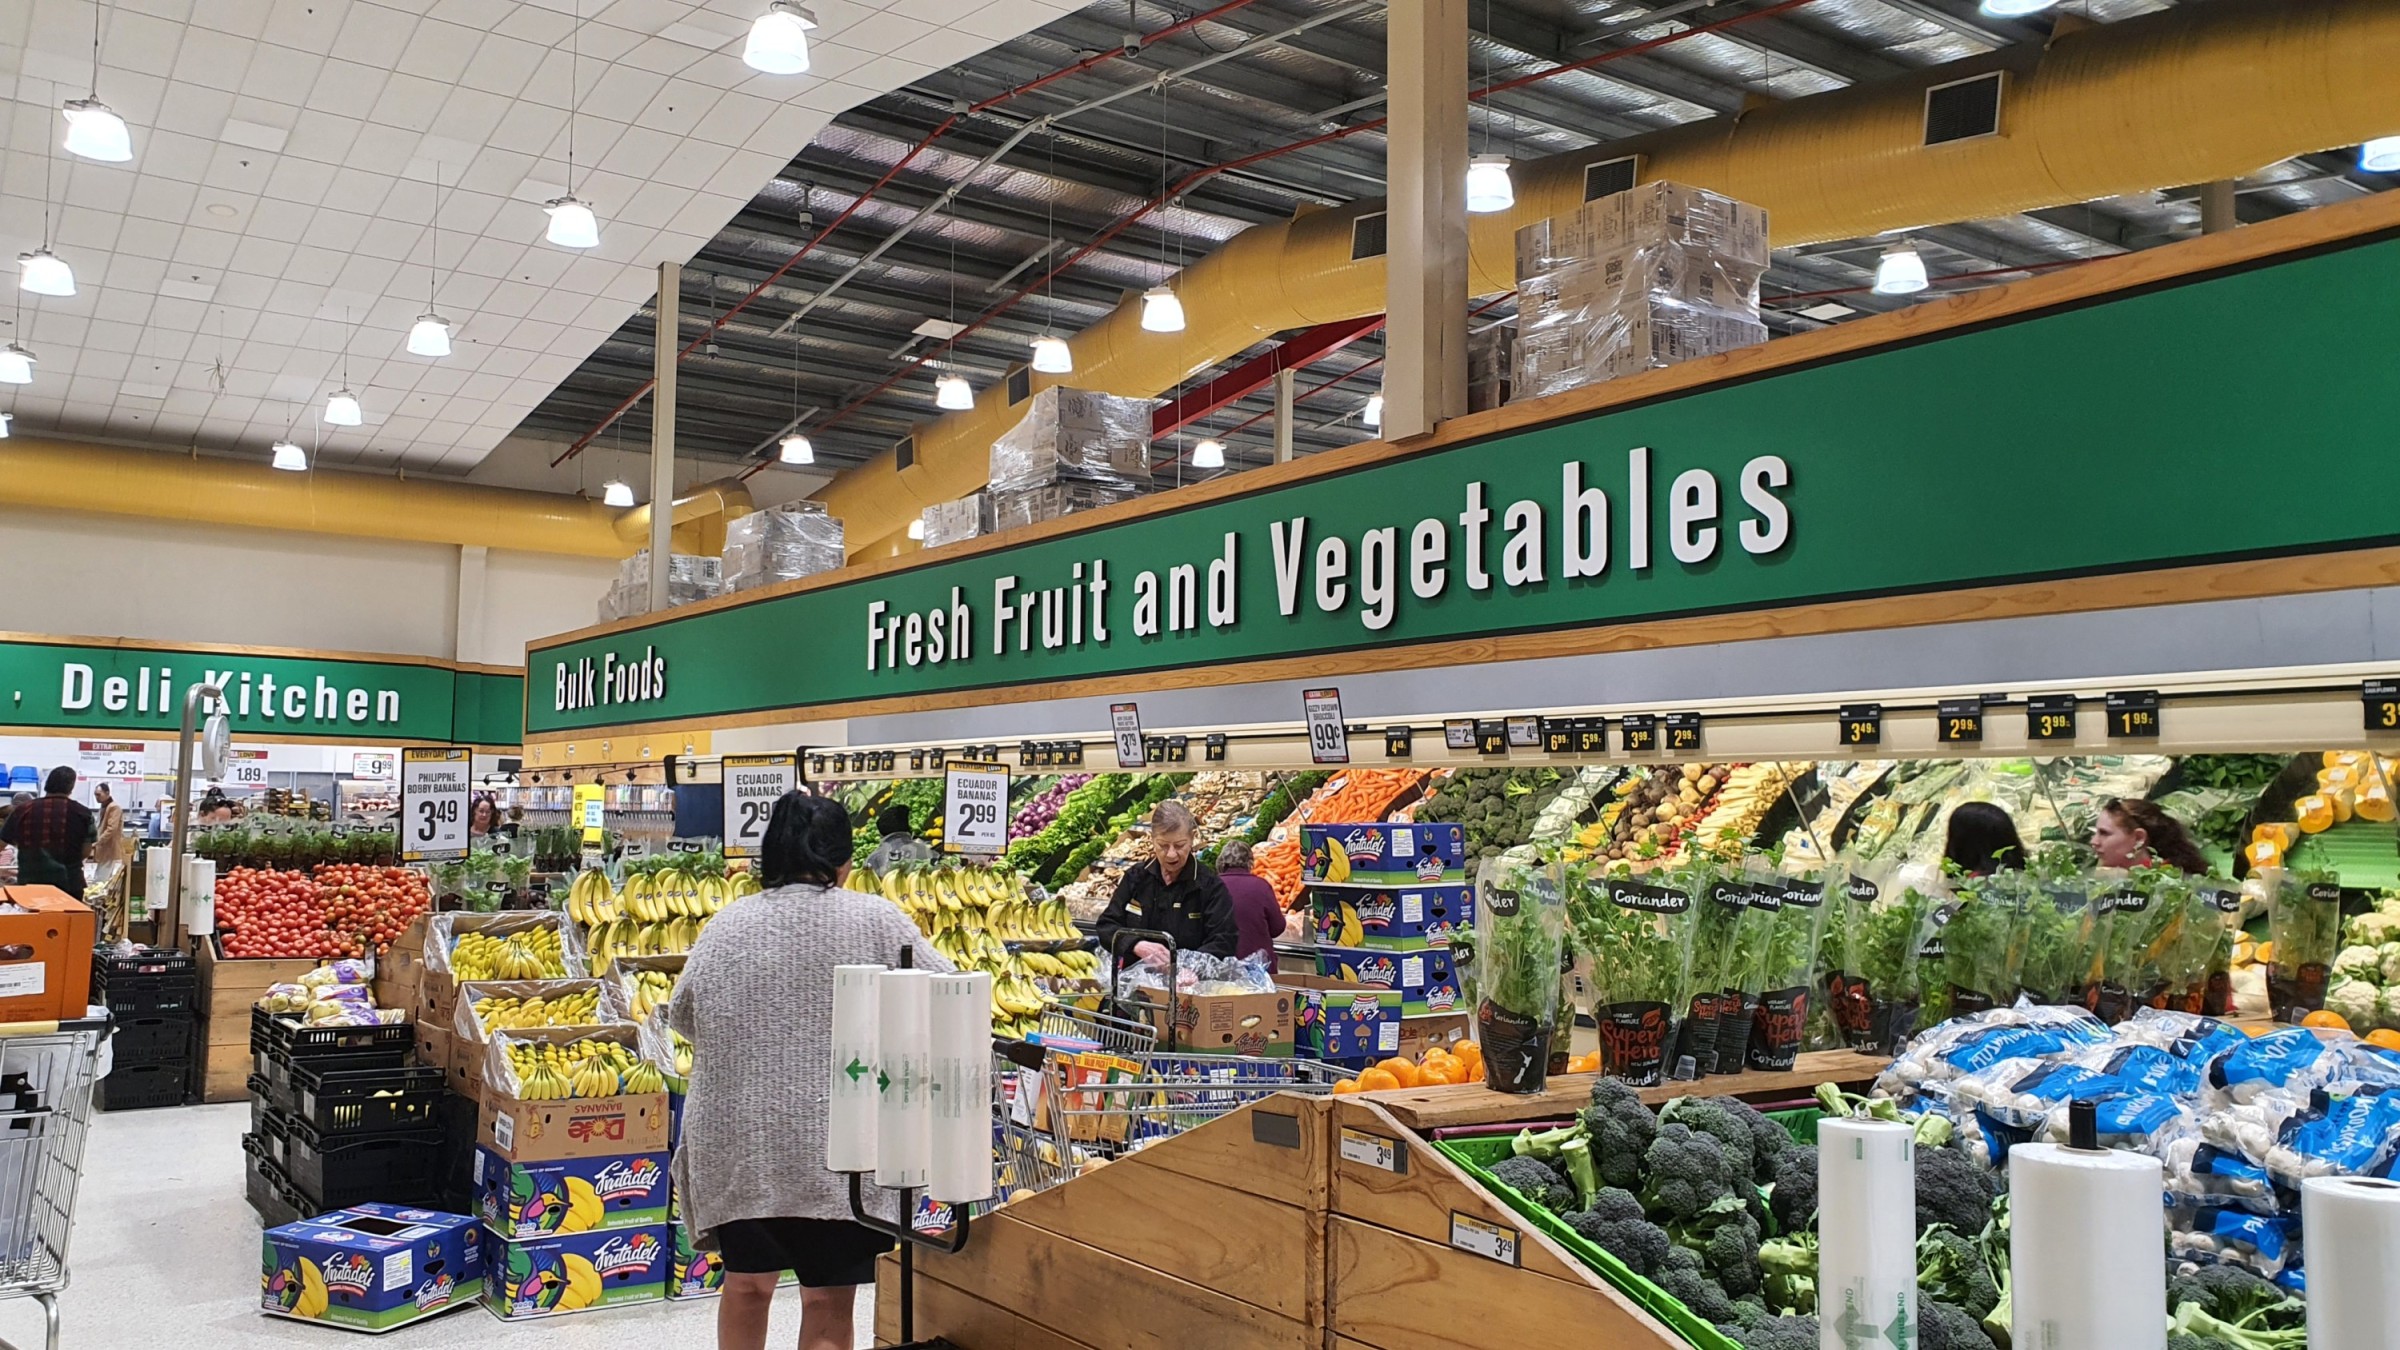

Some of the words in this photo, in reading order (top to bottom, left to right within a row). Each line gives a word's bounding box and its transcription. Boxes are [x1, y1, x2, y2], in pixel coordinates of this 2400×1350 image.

[867, 586, 969, 671] Fresh
[994, 559, 1107, 654] Fruit
[1133, 531, 1235, 637] and
[1270, 447, 1788, 630] Vegetables
[555, 657, 595, 711] Bulk
[603, 645, 664, 704] Foods
[61, 663, 171, 712] Deli
[203, 669, 399, 723] Kitchen
[2382, 702, 2400, 726] 3
[107, 760, 137, 775] 2.39
[236, 767, 262, 782] 1.89
[736, 773, 783, 785] ECUADOR
[407, 784, 432, 794] BOBBY
[433, 783, 466, 793] BANANAS
[736, 785, 783, 798] BANANAS
[957, 778, 998, 790] ECUADOR
[957, 789, 997, 801] BANANAS
[1344, 828, 1386, 855] Frutadeli
[1356, 892, 1397, 919] Frutadeli
[1615, 889, 1685, 908] Coriander
[1357, 956, 1397, 983] Frutadeli
[574, 1102, 623, 1113] BANANAS
[567, 1118, 625, 1143] Dole
[594, 1161, 662, 1195] Frutadeli
[594, 1236, 662, 1272] Frutadeli
[322, 1251, 375, 1287] Frutadeli
[415, 1279, 455, 1308] Frutadeli
[1846, 1288, 1854, 1310] END
[1897, 1292, 1905, 1314] END
